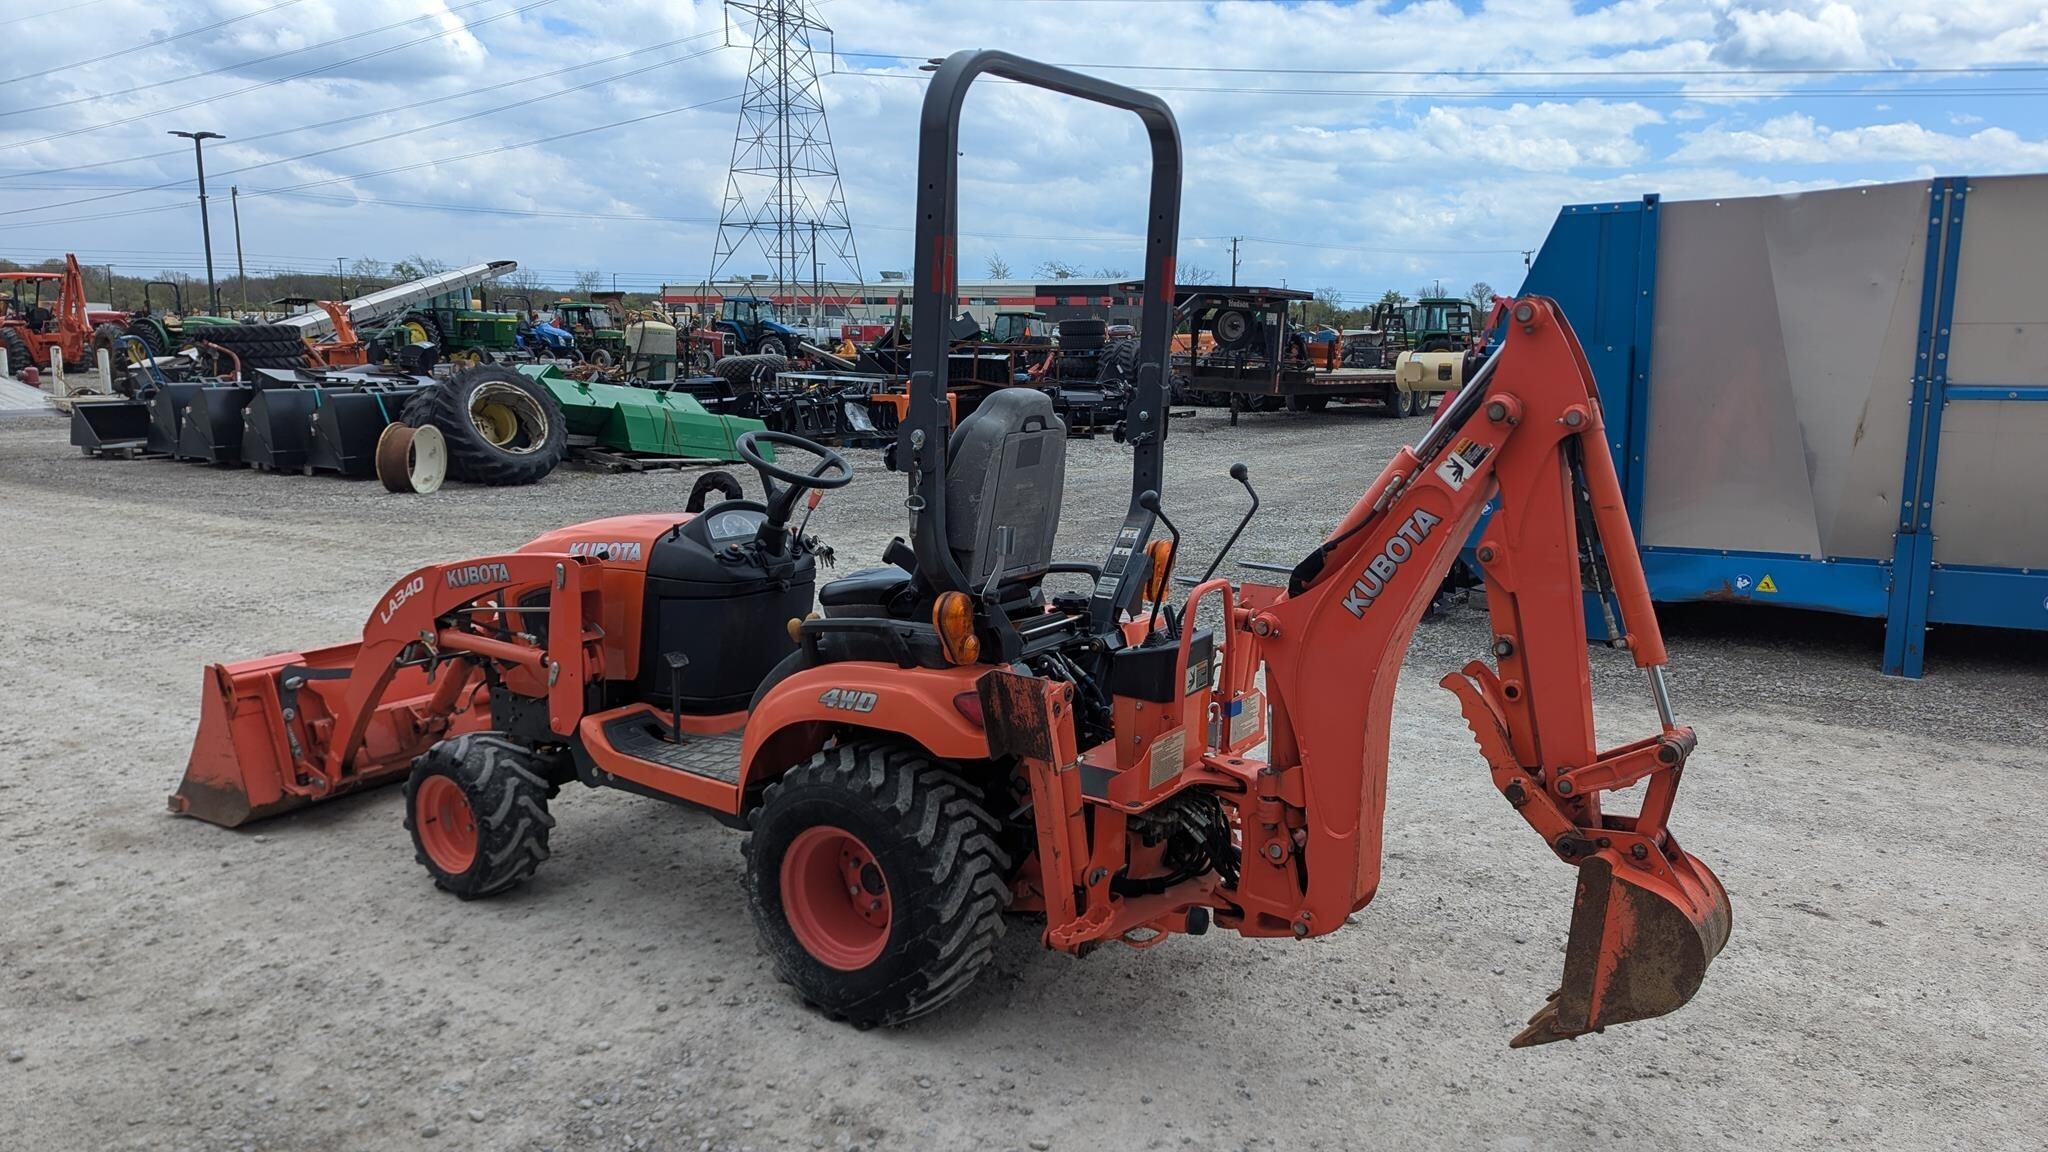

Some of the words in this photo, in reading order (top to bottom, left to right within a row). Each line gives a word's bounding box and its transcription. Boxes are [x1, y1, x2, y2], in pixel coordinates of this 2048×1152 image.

[570, 542, 641, 561] KUBOTA
[1341, 508, 1442, 619] KUBOTA
[446, 563, 510, 588] KUBOTA
[380, 576, 425, 625] LA340
[818, 687, 879, 713] 4WD
